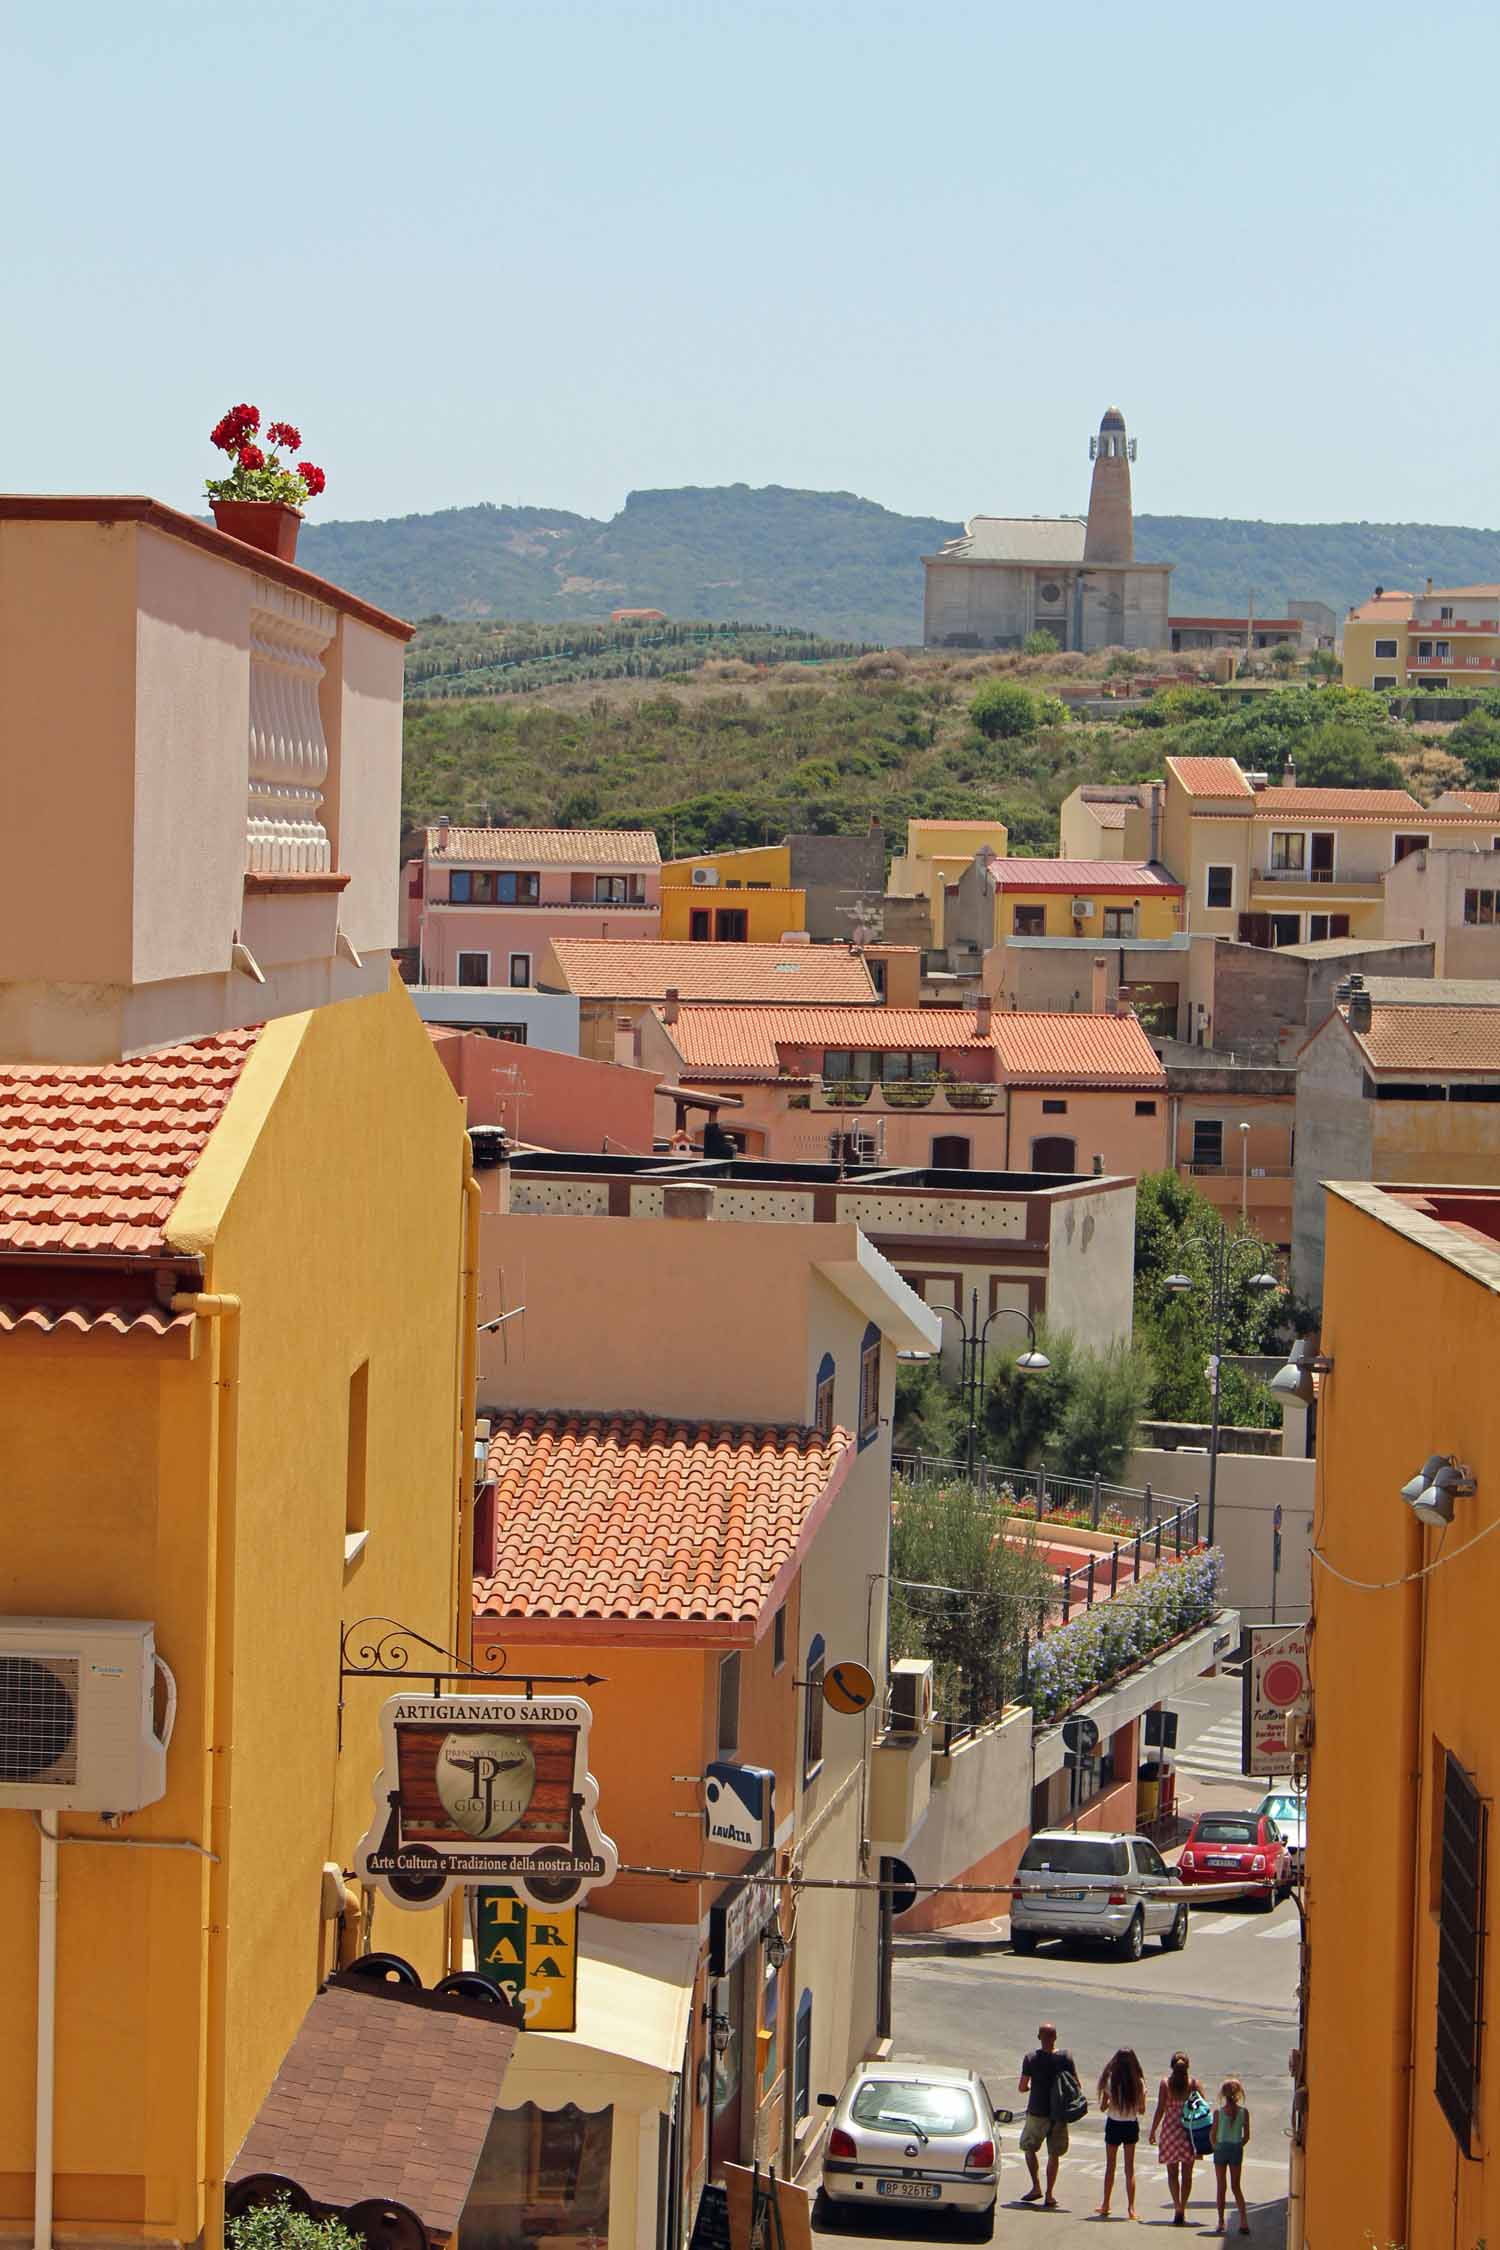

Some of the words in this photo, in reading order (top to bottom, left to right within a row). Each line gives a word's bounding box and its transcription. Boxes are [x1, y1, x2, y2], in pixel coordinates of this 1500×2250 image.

[395, 1705, 516, 1720] ARTIGIANATO
[520, 1706, 578, 1721] SARDO
[454, 1799, 522, 1812] GIOELLI
[712, 1823, 752, 1844] LAVAZZA
[371, 1855, 395, 1869] Arte
[397, 1855, 438, 1869] Cultura
[440, 1859, 447, 1869] e
[448, 1855, 507, 1871] Tradizione
[509, 1856, 536, 1871] della
[537, 1858, 572, 1872] nostra
[574, 1857, 600, 1872] Isola
[886, 2183, 898, 2193] BP
